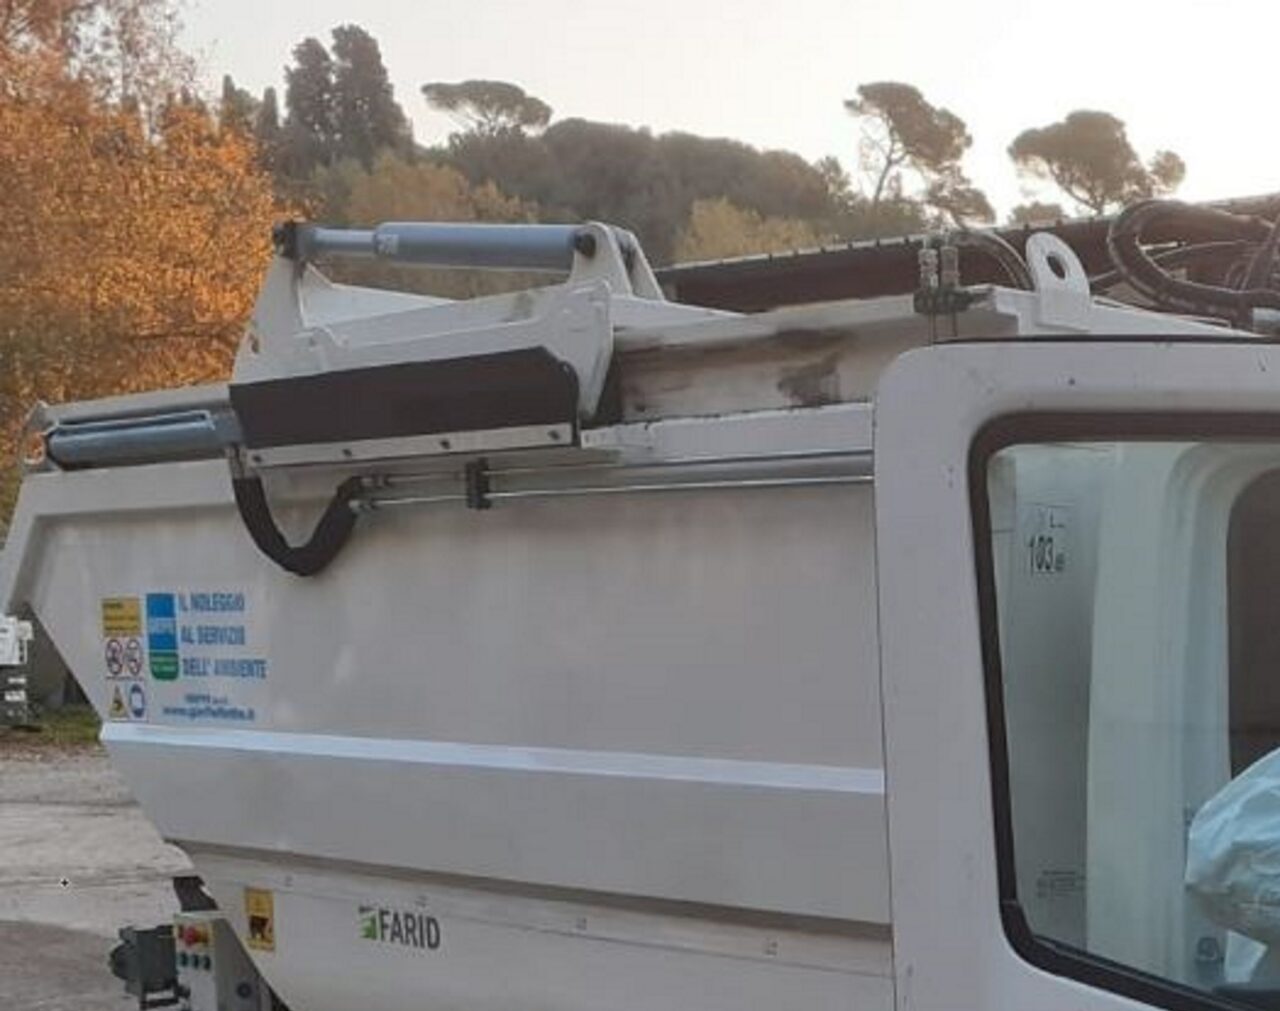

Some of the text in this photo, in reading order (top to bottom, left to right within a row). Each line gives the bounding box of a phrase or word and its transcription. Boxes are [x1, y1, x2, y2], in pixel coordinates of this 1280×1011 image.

[190, 593, 245, 612] NOLEGGIO
[181, 626, 194, 644] AL
[196, 626, 245, 646] SERVIZIO
[213, 659, 267, 679] AMBIENTE
[379, 908, 441, 951] FARID
